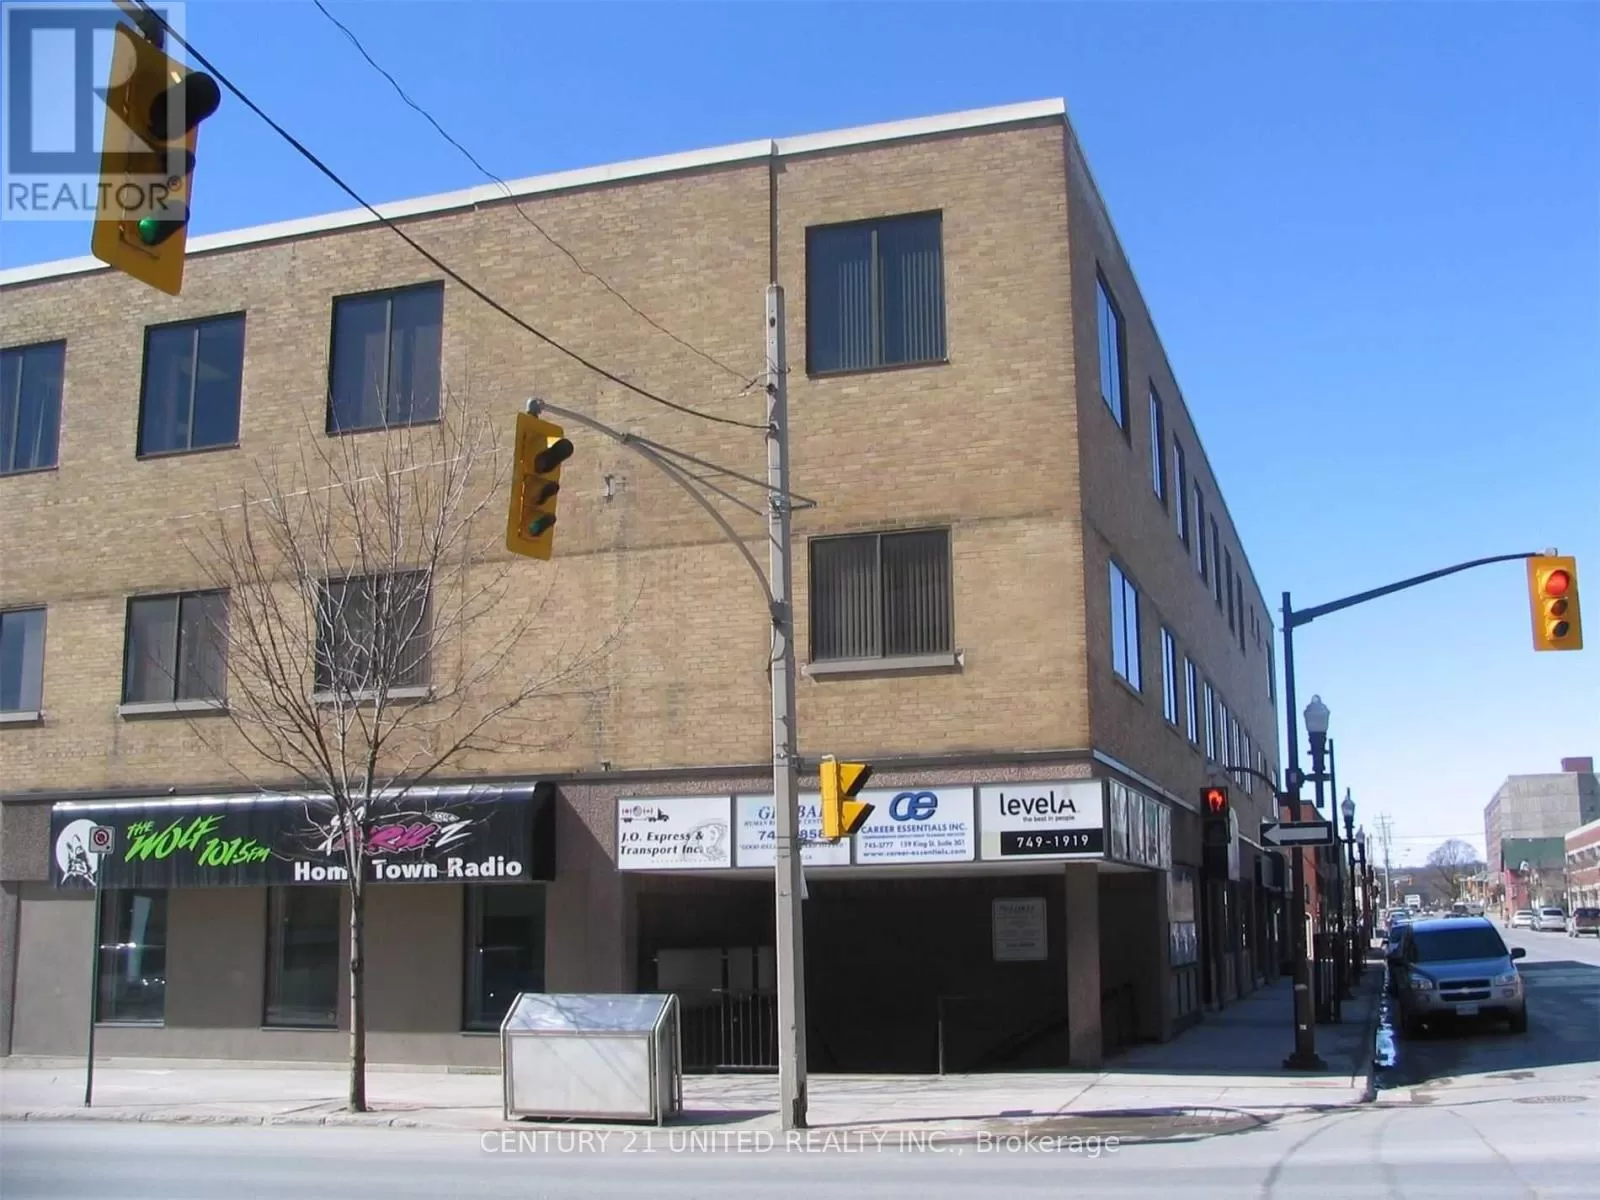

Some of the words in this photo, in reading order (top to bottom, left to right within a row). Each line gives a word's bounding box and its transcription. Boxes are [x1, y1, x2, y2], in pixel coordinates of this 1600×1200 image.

[861, 824, 894, 834] CAREER
[897, 823, 947, 832] ESSENTIALS
[949, 822, 968, 831] INC.
[621, 831, 642, 843] J.O.
[646, 831, 691, 843] Express
[695, 830, 704, 841] &
[1017, 834, 1089, 848] 749-1919
[620, 845, 677, 857] Transport
[682, 844, 704, 854] Inc.
[294, 860, 350, 881] Hom
[371, 858, 438, 879] Town
[447, 855, 522, 878] Radio
